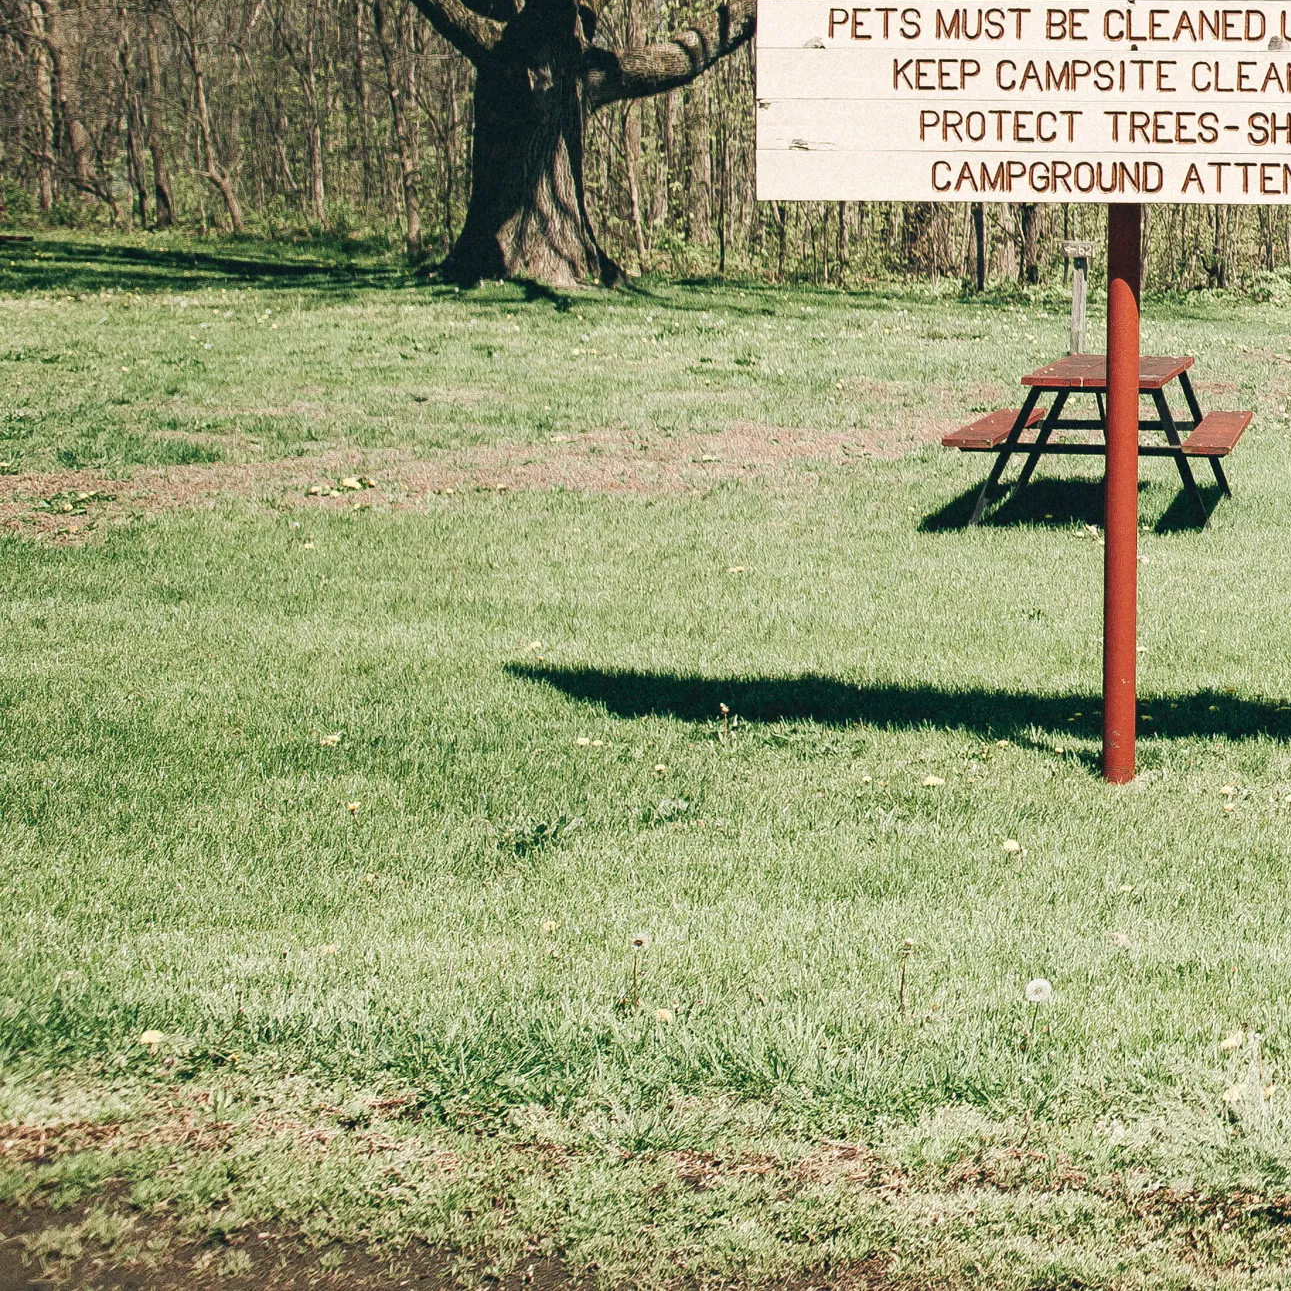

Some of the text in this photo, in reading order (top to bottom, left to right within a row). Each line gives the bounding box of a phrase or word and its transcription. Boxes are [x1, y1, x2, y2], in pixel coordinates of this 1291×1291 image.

[828, 7, 921, 40] PETS
[935, 7, 1032, 40] MUST
[1045, 8, 1090, 41] BE
[1103, 8, 1266, 42] CLEANED
[893, 58, 981, 91] KEEP
[995, 59, 1178, 93] CAMPSITE
[919, 109, 1084, 143] PROTECT
[931, 160, 1164, 194] CAMPGROUND
